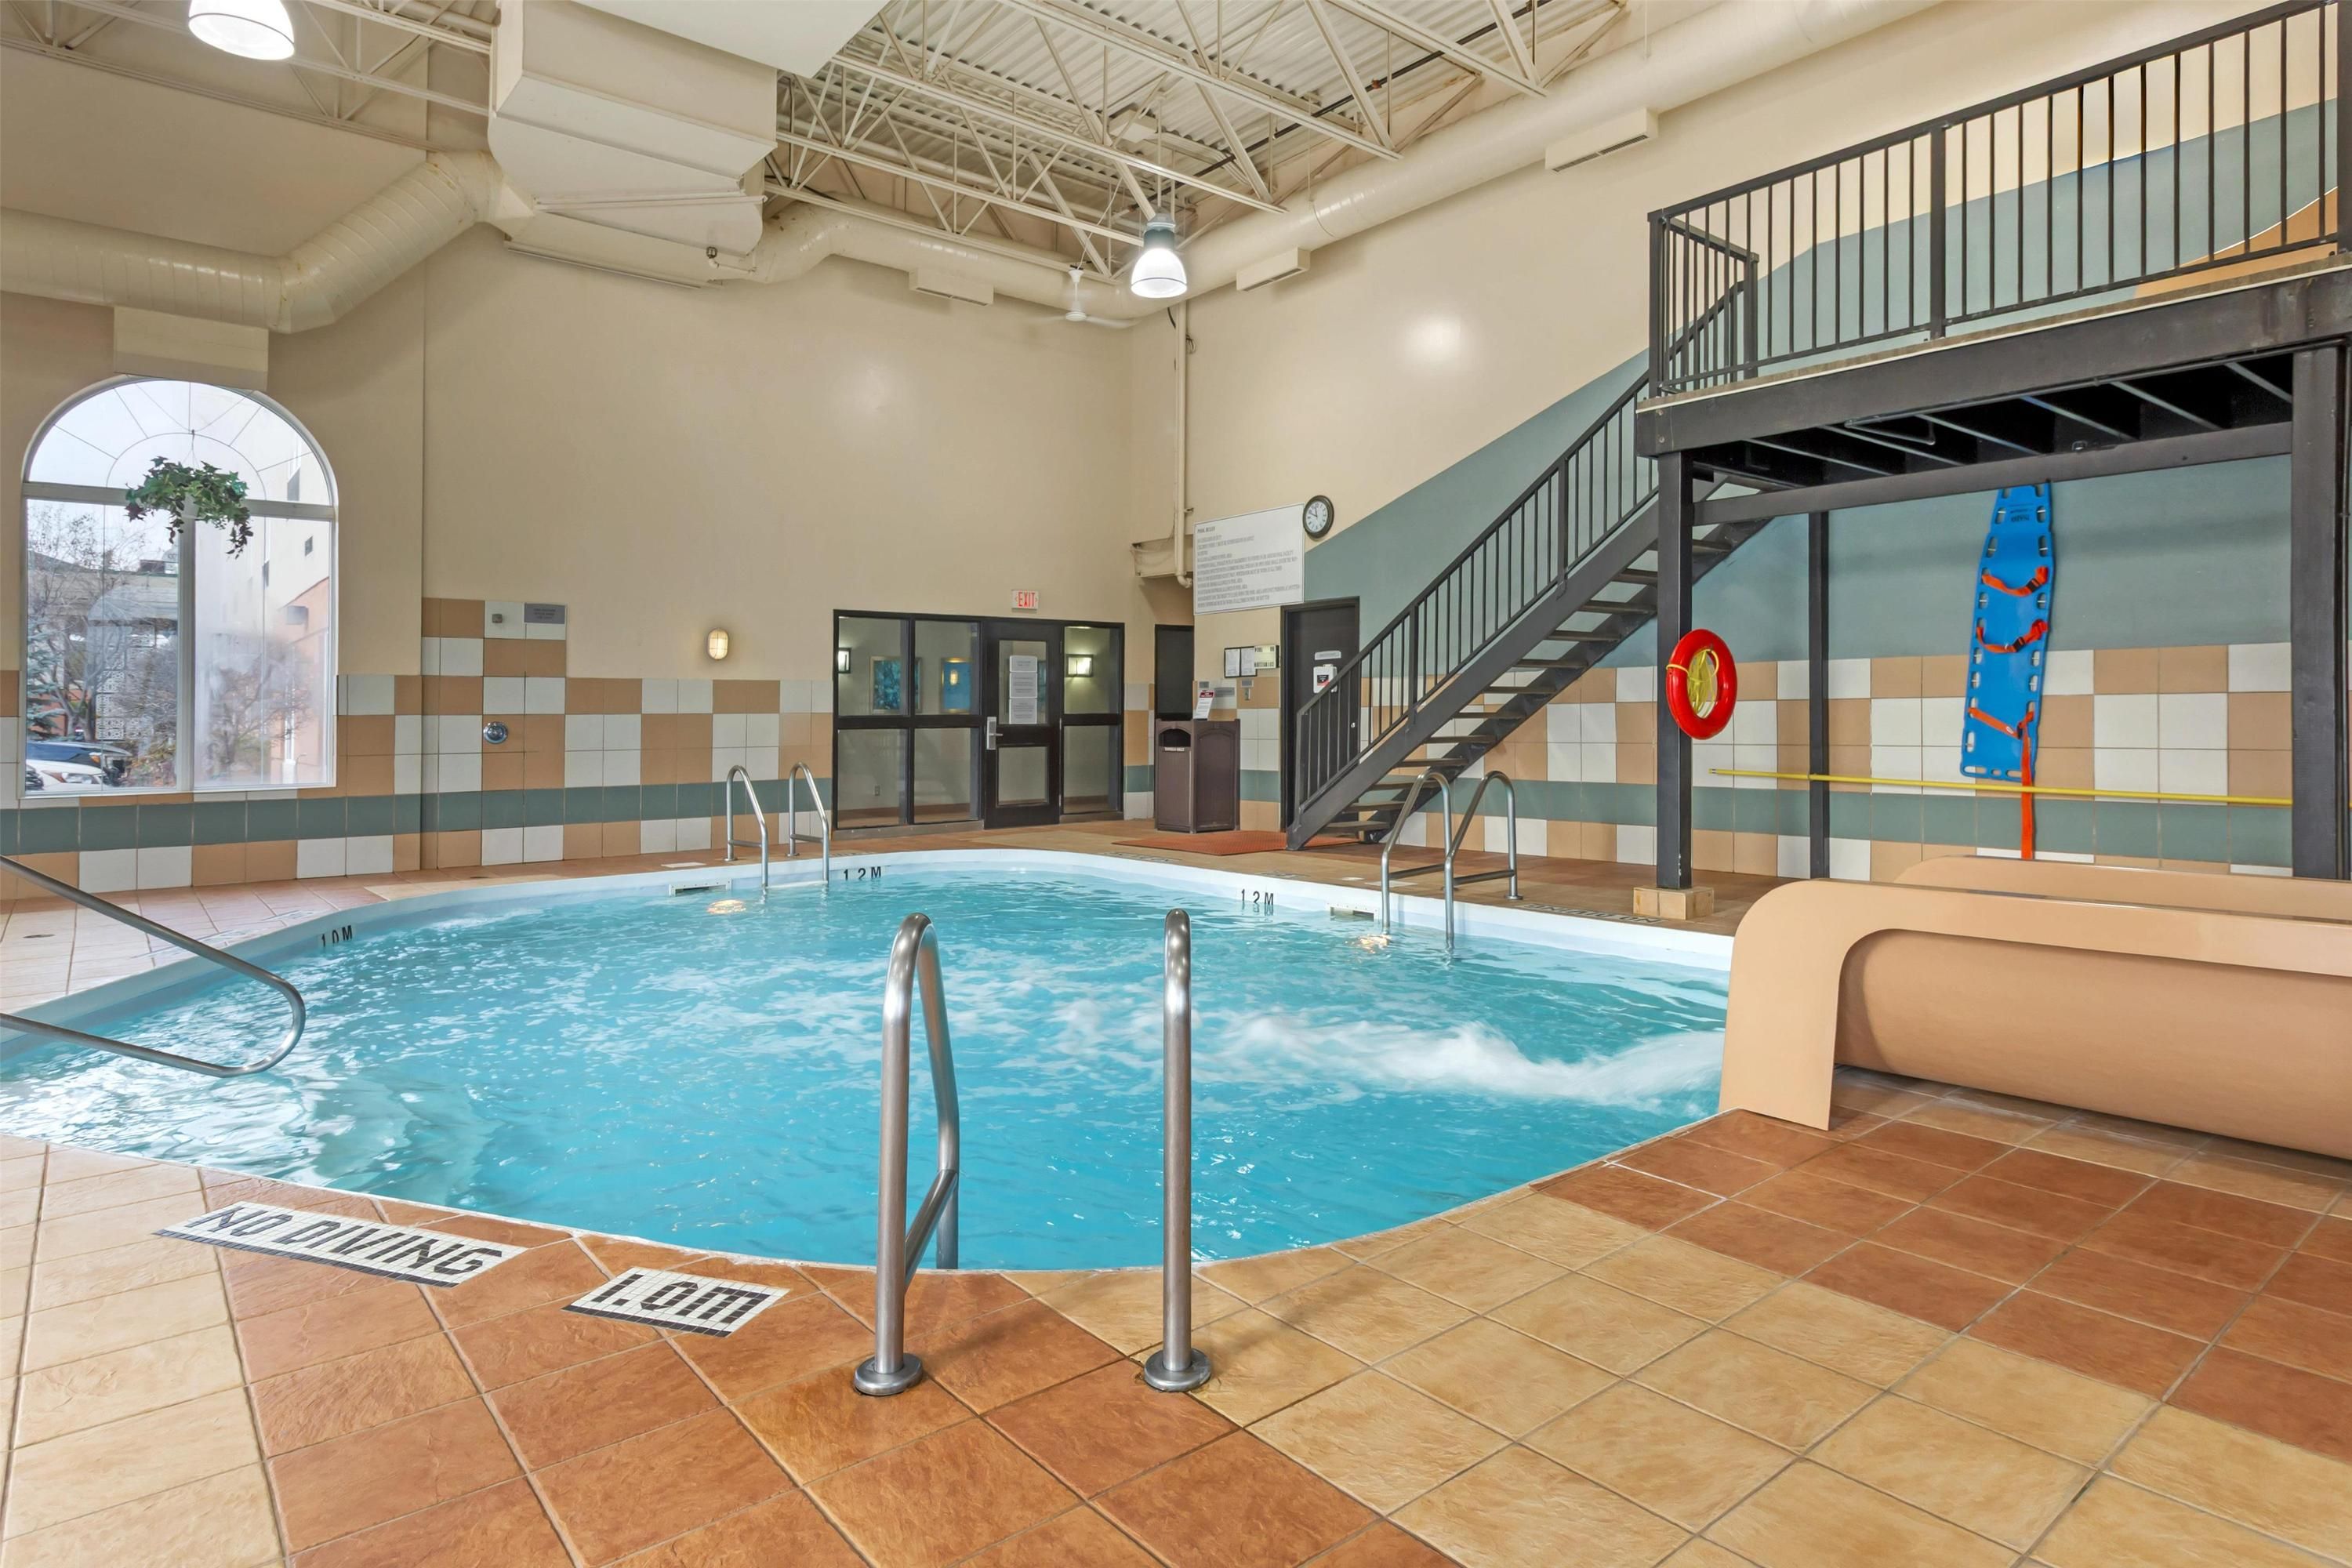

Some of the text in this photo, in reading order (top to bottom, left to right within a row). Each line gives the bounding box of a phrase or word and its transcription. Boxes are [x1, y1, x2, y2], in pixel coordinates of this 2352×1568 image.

[1018, 592, 1036, 608] EXIT
[185, 1206, 503, 1276] NO DIVING
